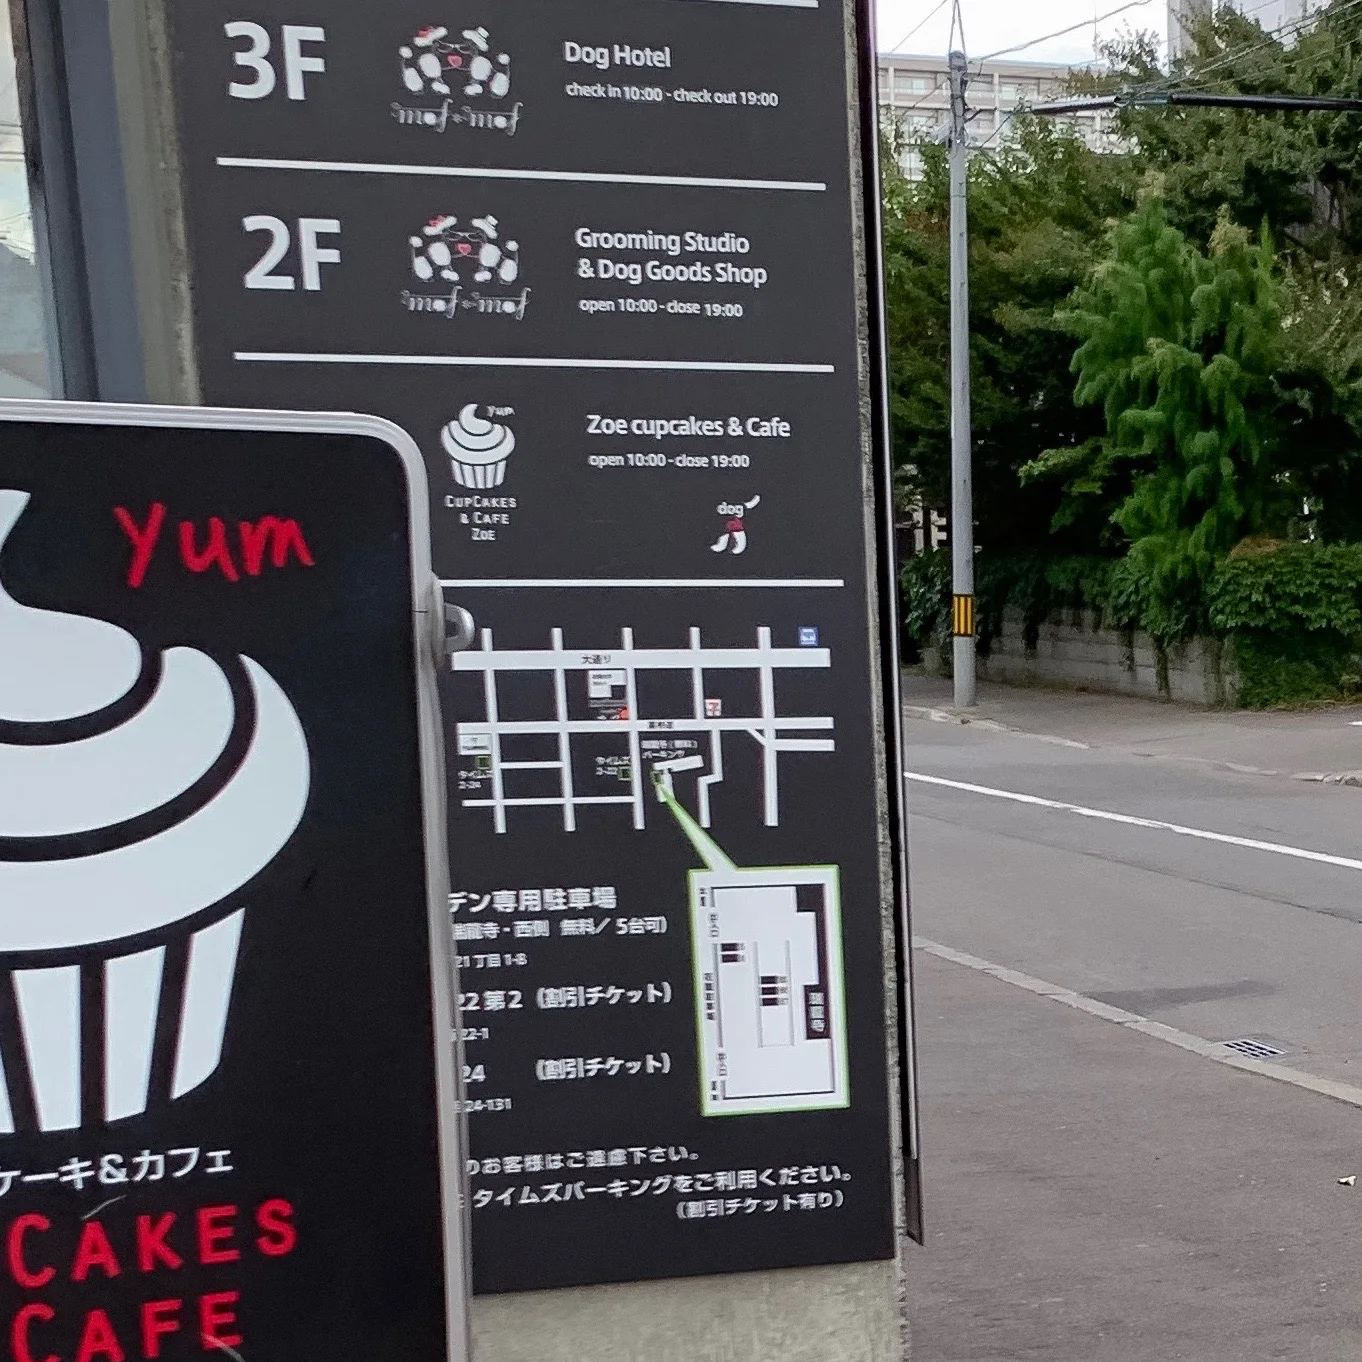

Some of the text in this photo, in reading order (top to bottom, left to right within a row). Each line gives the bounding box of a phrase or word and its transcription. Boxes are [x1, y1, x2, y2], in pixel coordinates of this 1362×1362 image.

[224, 21, 326, 101] 3F
[565, 41, 671, 70] Dog Hotel
[565, 82, 606, 98] check
[608, 84, 621, 98] in
[623, 86, 663, 101] 10:00
[673, 88, 712, 103] check
[714, 90, 738, 104] out
[740, 91, 779, 106] 19:00
[242, 215, 341, 291] 2F
[575, 227, 750, 256] Grooming Studio
[578, 258, 768, 288] & Dog Goods Shop
[579, 299, 616, 314] open
[704, 303, 744, 317] 19:00
[586, 414, 791, 439] Zoe cupcakes & Cafe
[588, 454, 625, 468] open
[711, 454, 750, 467] 19:00
[717, 502, 744, 518] dog
[6, 1198, 298, 1288] CAKES
